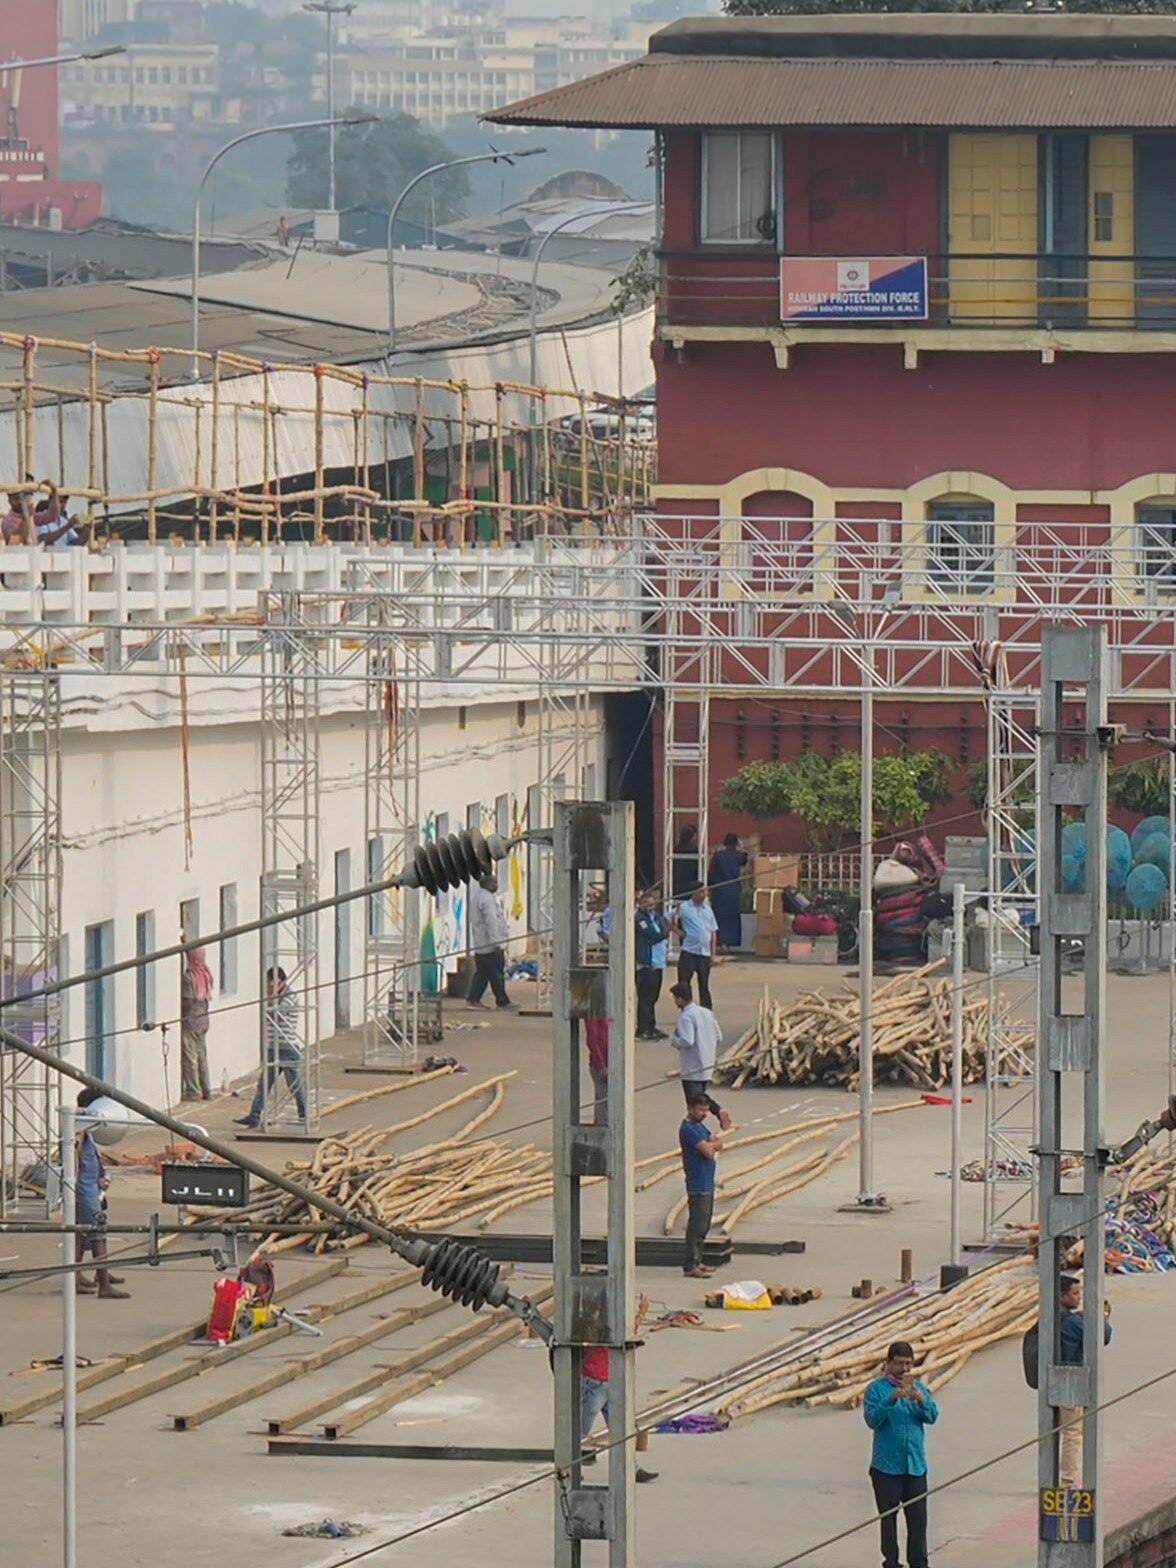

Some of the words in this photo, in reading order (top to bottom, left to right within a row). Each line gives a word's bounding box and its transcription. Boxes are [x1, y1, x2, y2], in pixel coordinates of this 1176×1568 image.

[788, 292, 828, 304] RAILWAY
[830, 292, 887, 304] PROTECTION
[889, 292, 920, 304] FORCE
